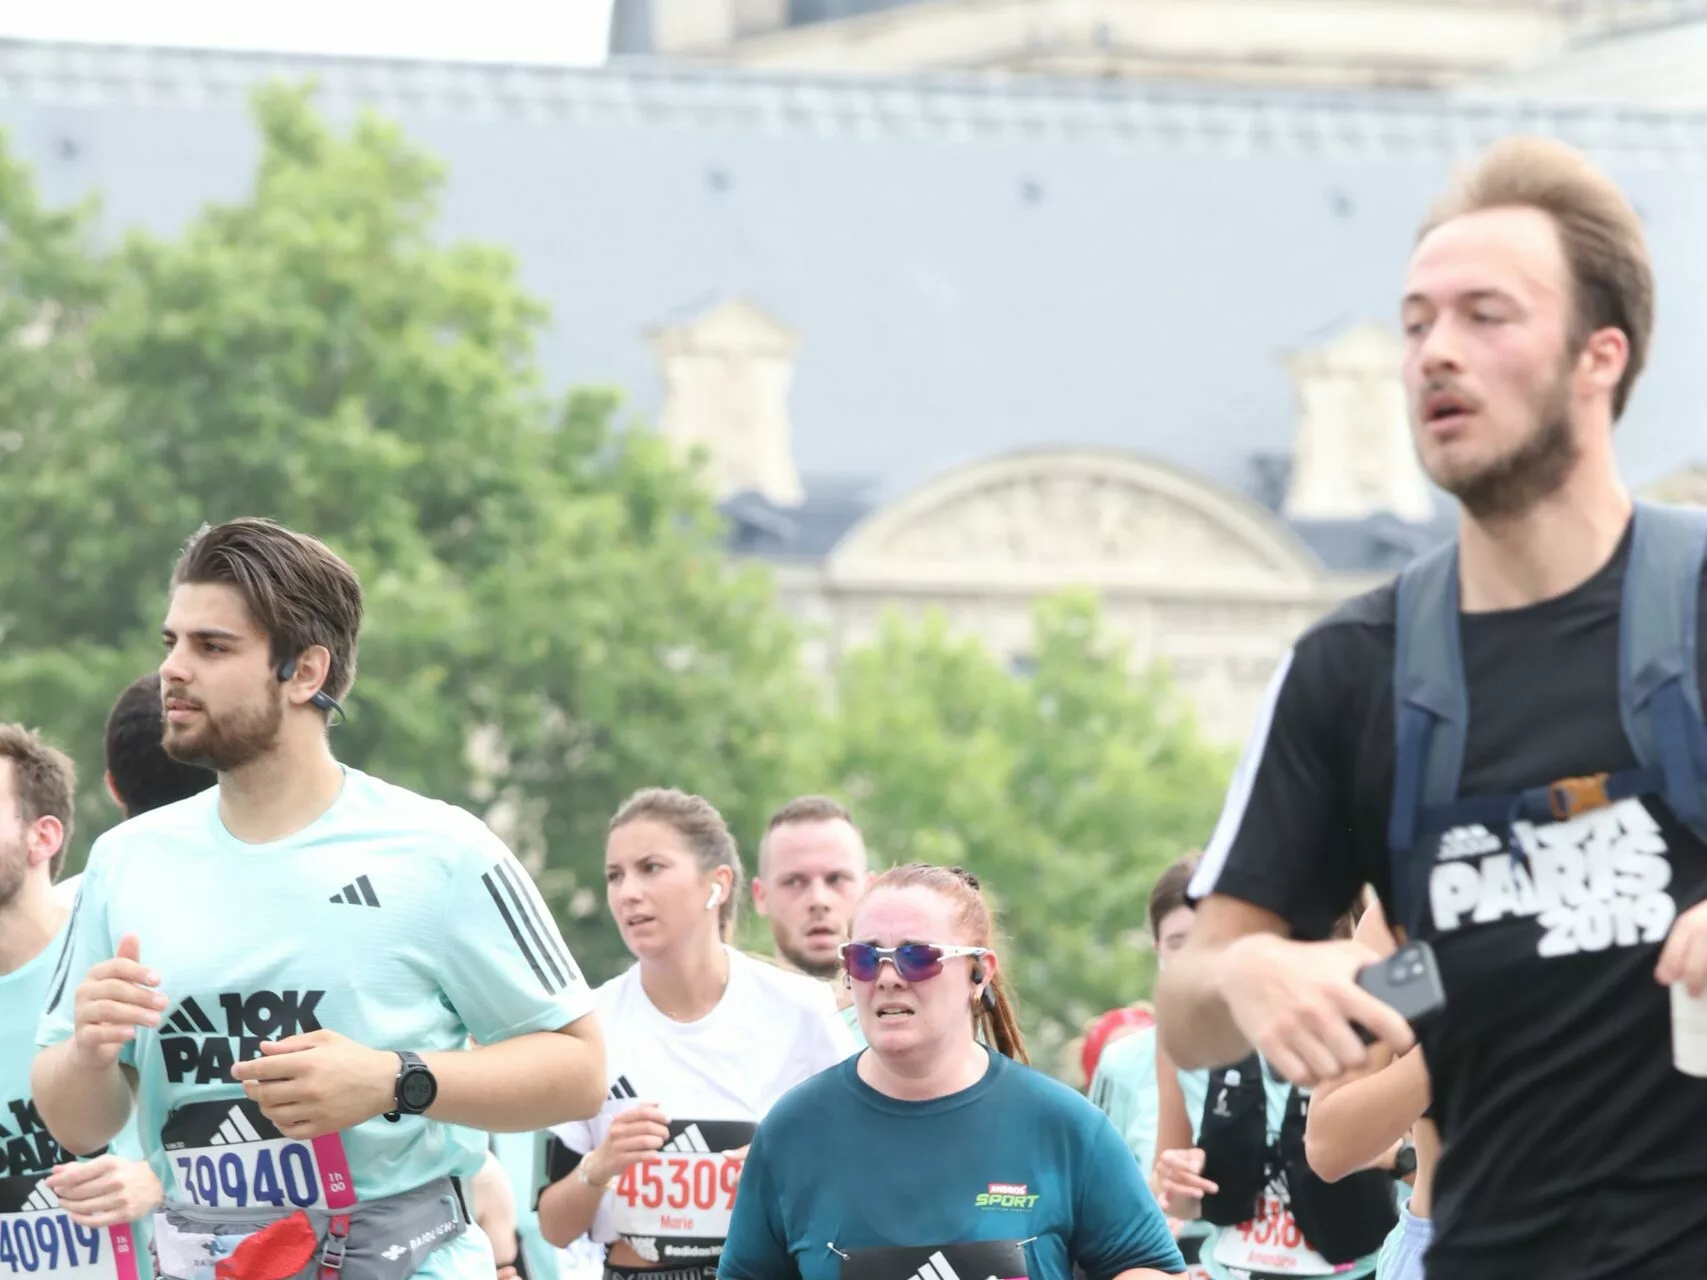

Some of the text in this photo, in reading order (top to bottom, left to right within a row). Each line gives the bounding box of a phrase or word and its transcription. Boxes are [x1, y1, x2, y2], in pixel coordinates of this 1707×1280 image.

[1536, 891, 1676, 957] 2019
[219, 990, 326, 1038] 10K
[177, 1143, 319, 1208] 39940
[616, 1157, 742, 1210] 45309
[975, 1193, 1040, 1208] SPORT
[0, 1213, 100, 1272] 40919
[660, 1215, 694, 1230] Marie
